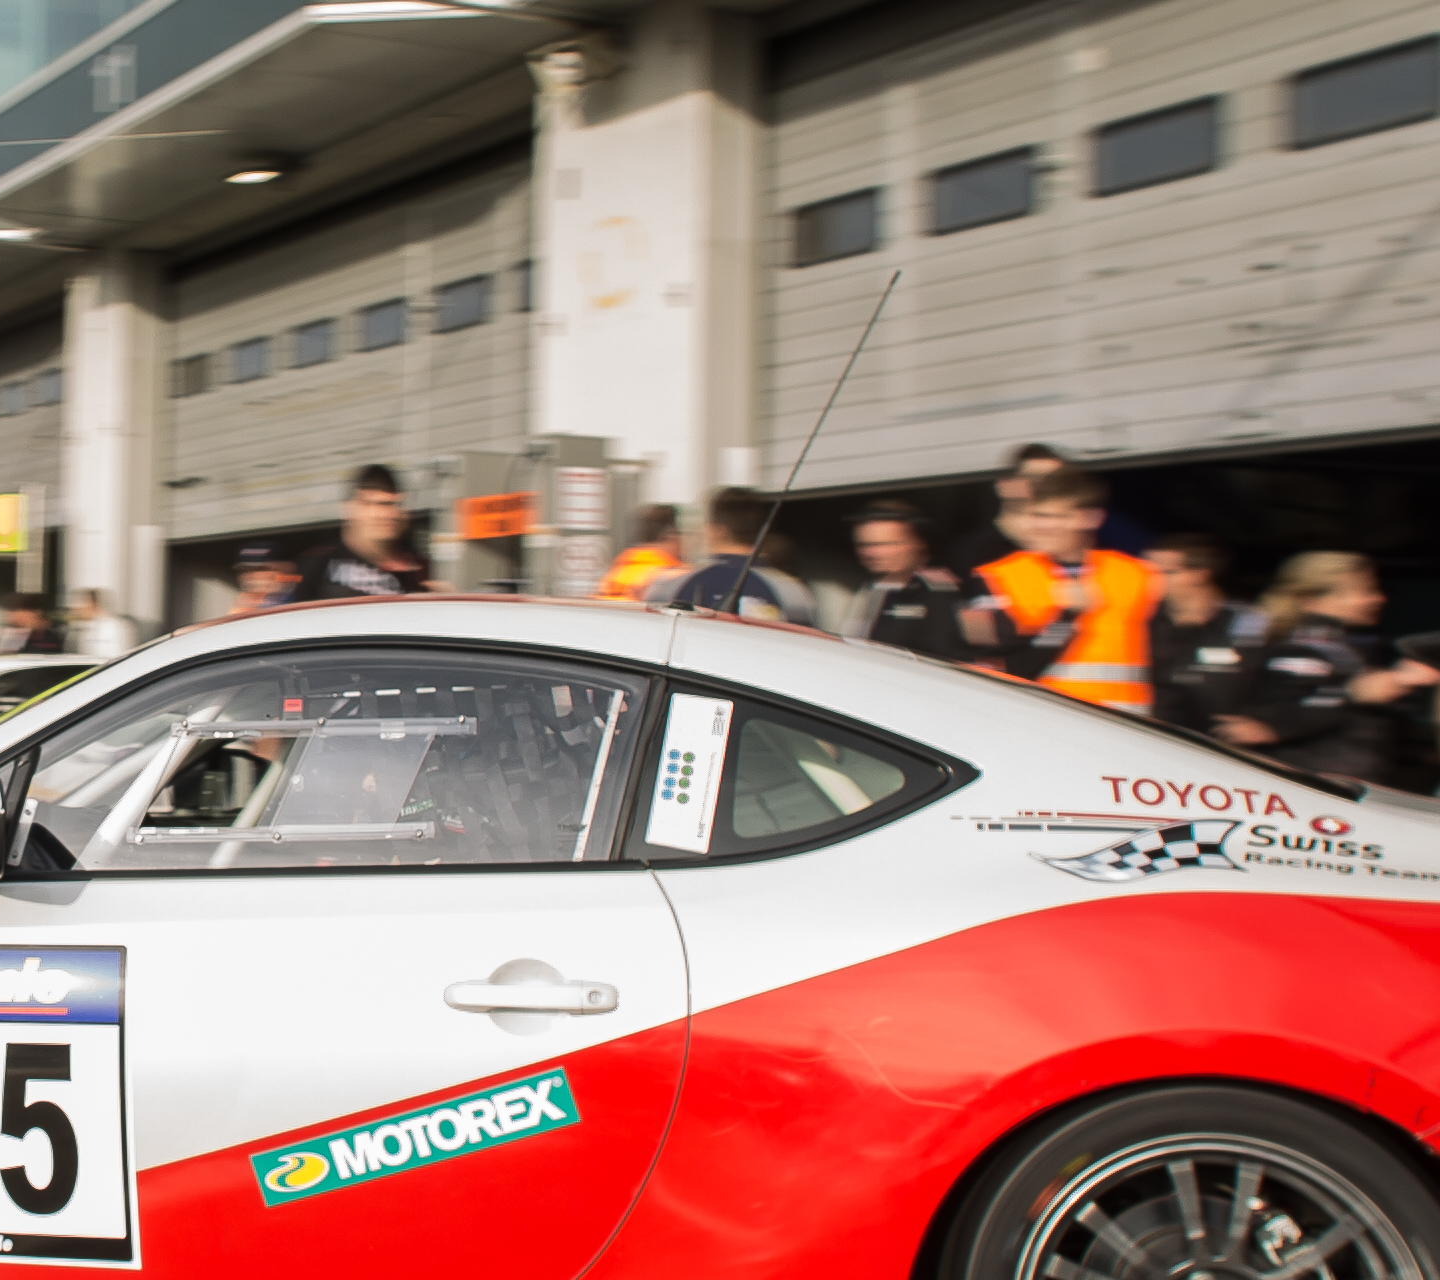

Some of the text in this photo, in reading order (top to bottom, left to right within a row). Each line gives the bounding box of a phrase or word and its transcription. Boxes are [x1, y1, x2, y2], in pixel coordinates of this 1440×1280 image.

[1101, 776, 1297, 819] TOYOTA
[1246, 824, 1385, 861] Swiss
[1244, 851, 1355, 877] Racing
[328, 1077, 568, 1181] MOTOREX
